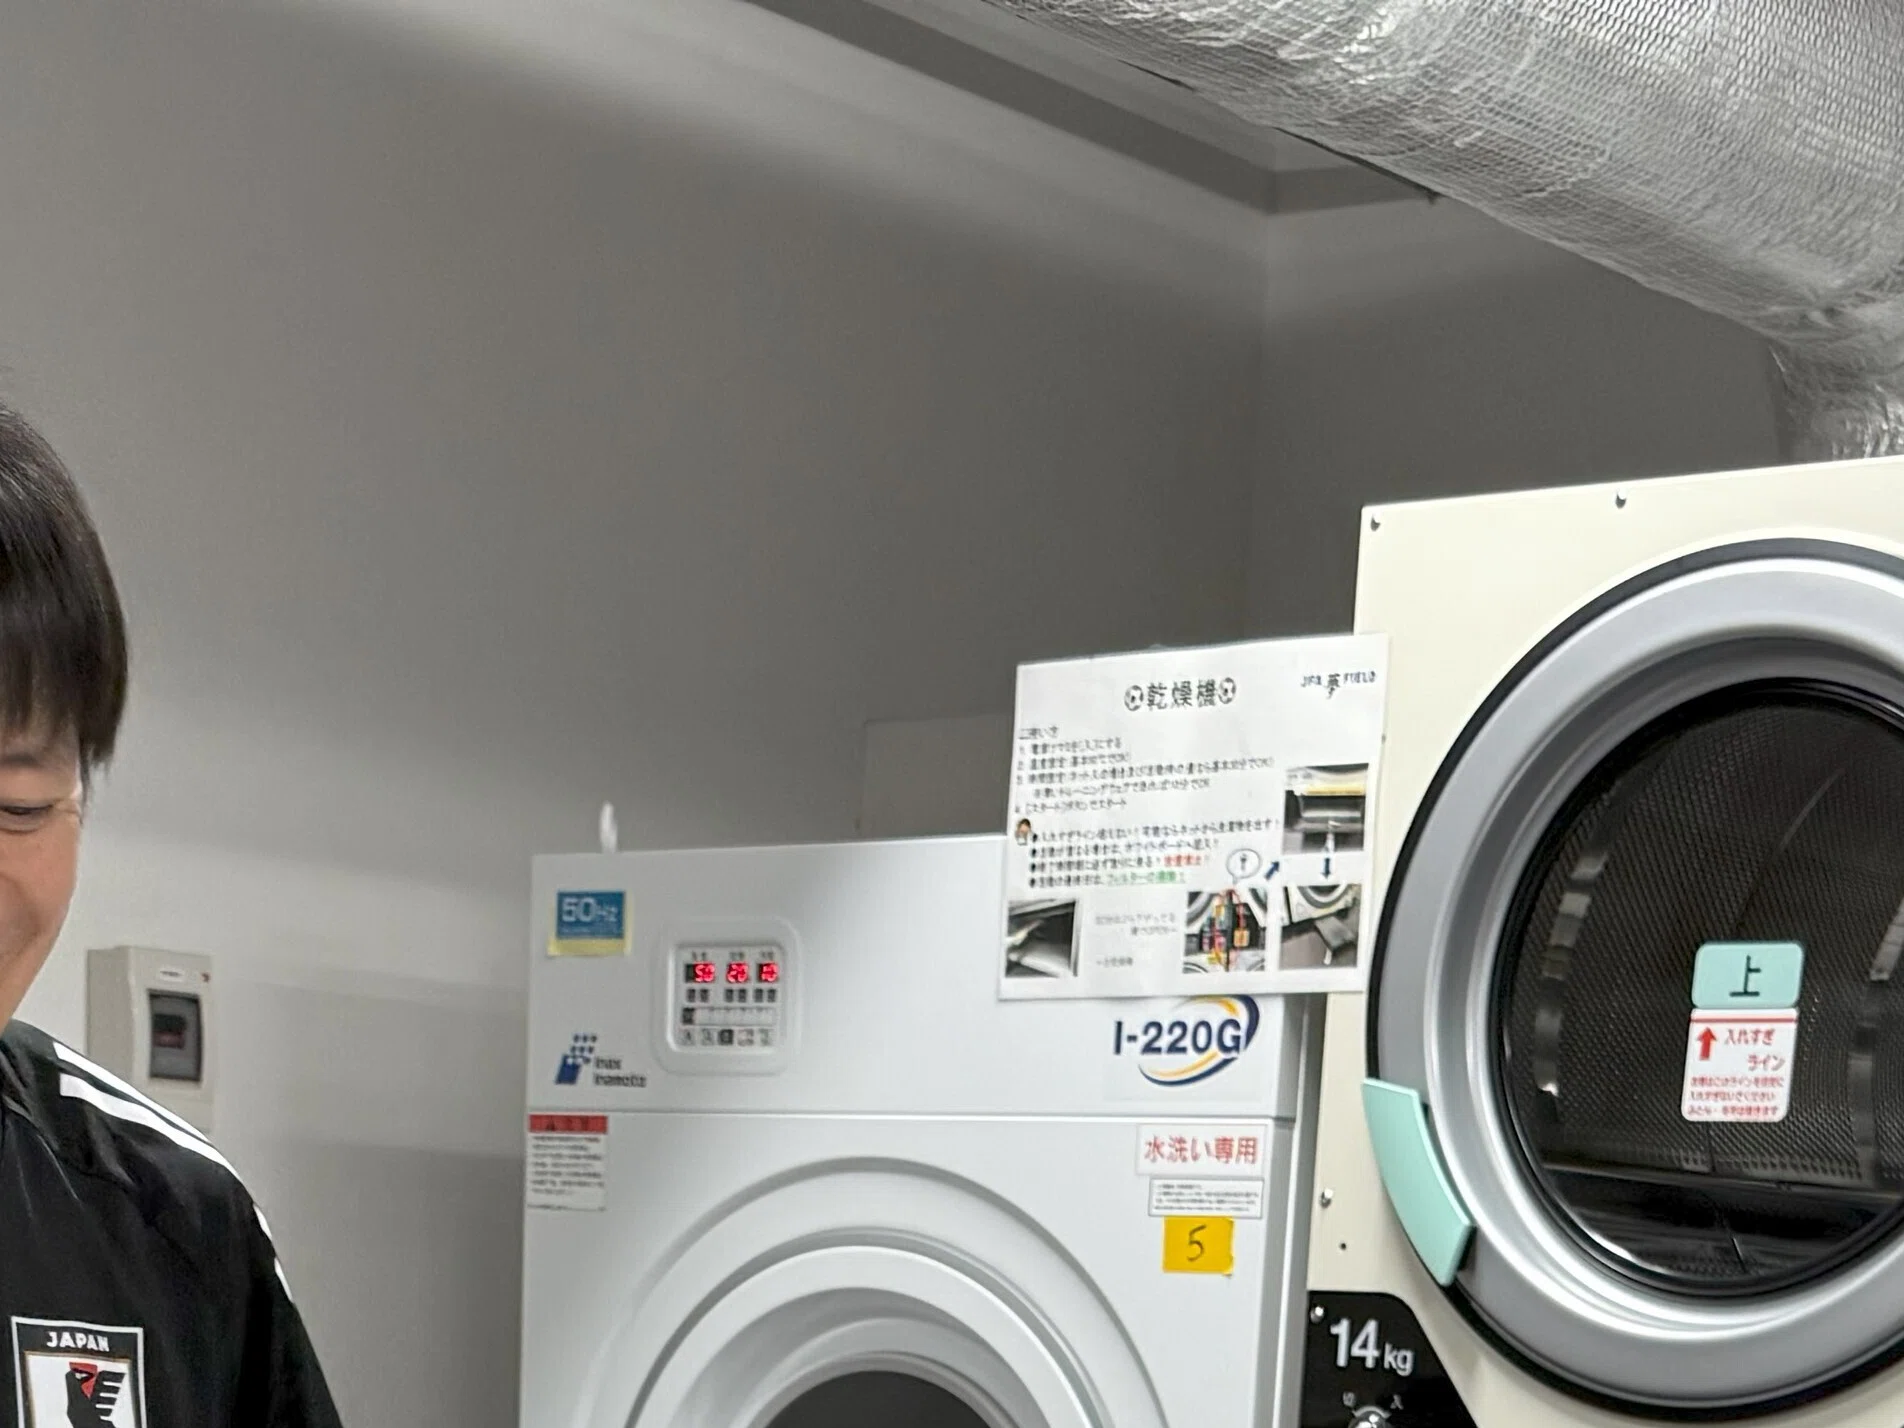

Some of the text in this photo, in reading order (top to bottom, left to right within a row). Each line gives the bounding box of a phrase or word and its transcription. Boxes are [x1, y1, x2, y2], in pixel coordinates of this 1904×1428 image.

[1147, 678, 1216, 710] 乾燥機
[1729, 955, 1761, 997] 上
[1113, 1018, 1242, 1055] I-220G
[1724, 1028, 1775, 1046] 入れすぎ
[1747, 1054, 1785, 1071] ライン
[1144, 1134, 1258, 1165] 水洗い専用
[1187, 1225, 1207, 1262] 5
[47, 1331, 110, 1352] JAPAN
[1330, 1318, 1414, 1377] 14kg
